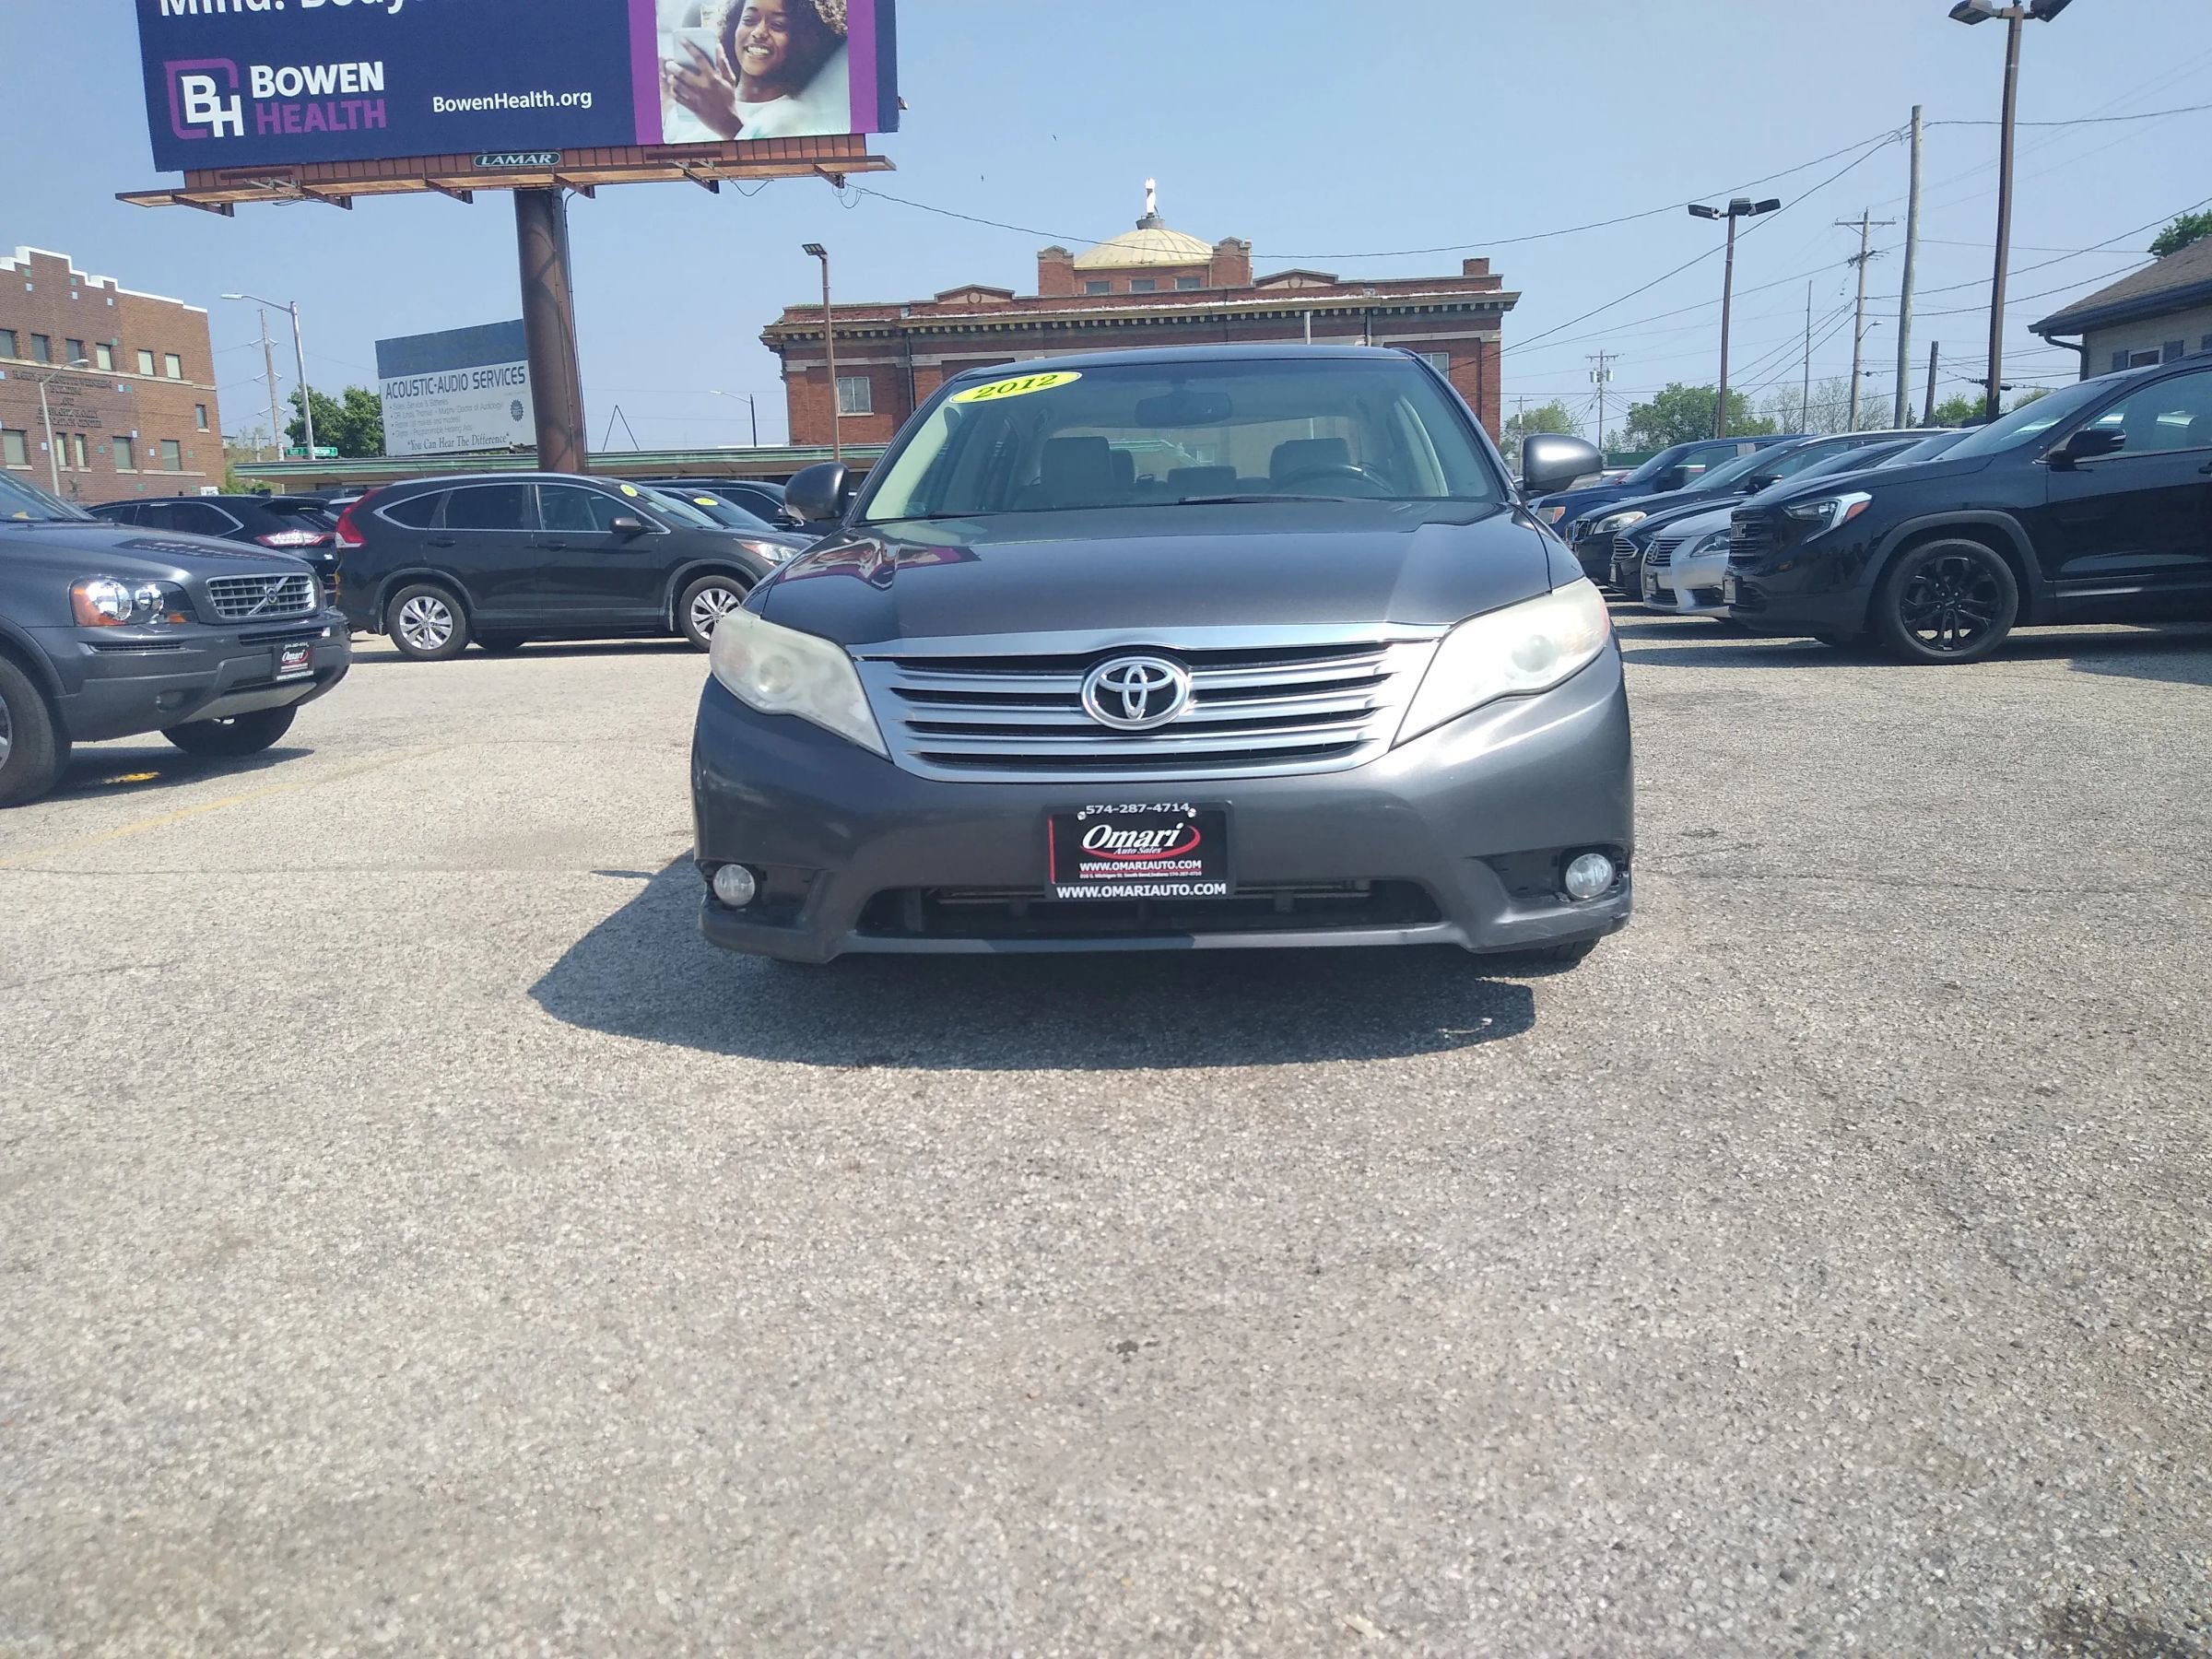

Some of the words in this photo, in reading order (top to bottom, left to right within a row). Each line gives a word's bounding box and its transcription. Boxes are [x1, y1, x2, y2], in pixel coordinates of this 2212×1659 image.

[250, 61, 384, 99] BOWEN
[432, 89, 593, 112] BowenHealth.org
[254, 99, 387, 135] HEALTH
[481, 154, 553, 166] LAMAR
[473, 366, 525, 389] SERVICES
[972, 374, 1058, 400] 2012
[424, 438, 437, 449] Can
[439, 436, 454, 448] Hear
[457, 435, 469, 447] The
[1086, 803, 1190, 815] 574-287-4714
[1081, 822, 1184, 850] Omari
[1113, 846, 1136, 855] Auto
[1137, 846, 1162, 855] Sales
[1079, 860, 1202, 871] WWW.OMARIAUTO.COM
[1056, 883, 1227, 899] WWW.OMARIAUTO.COM
